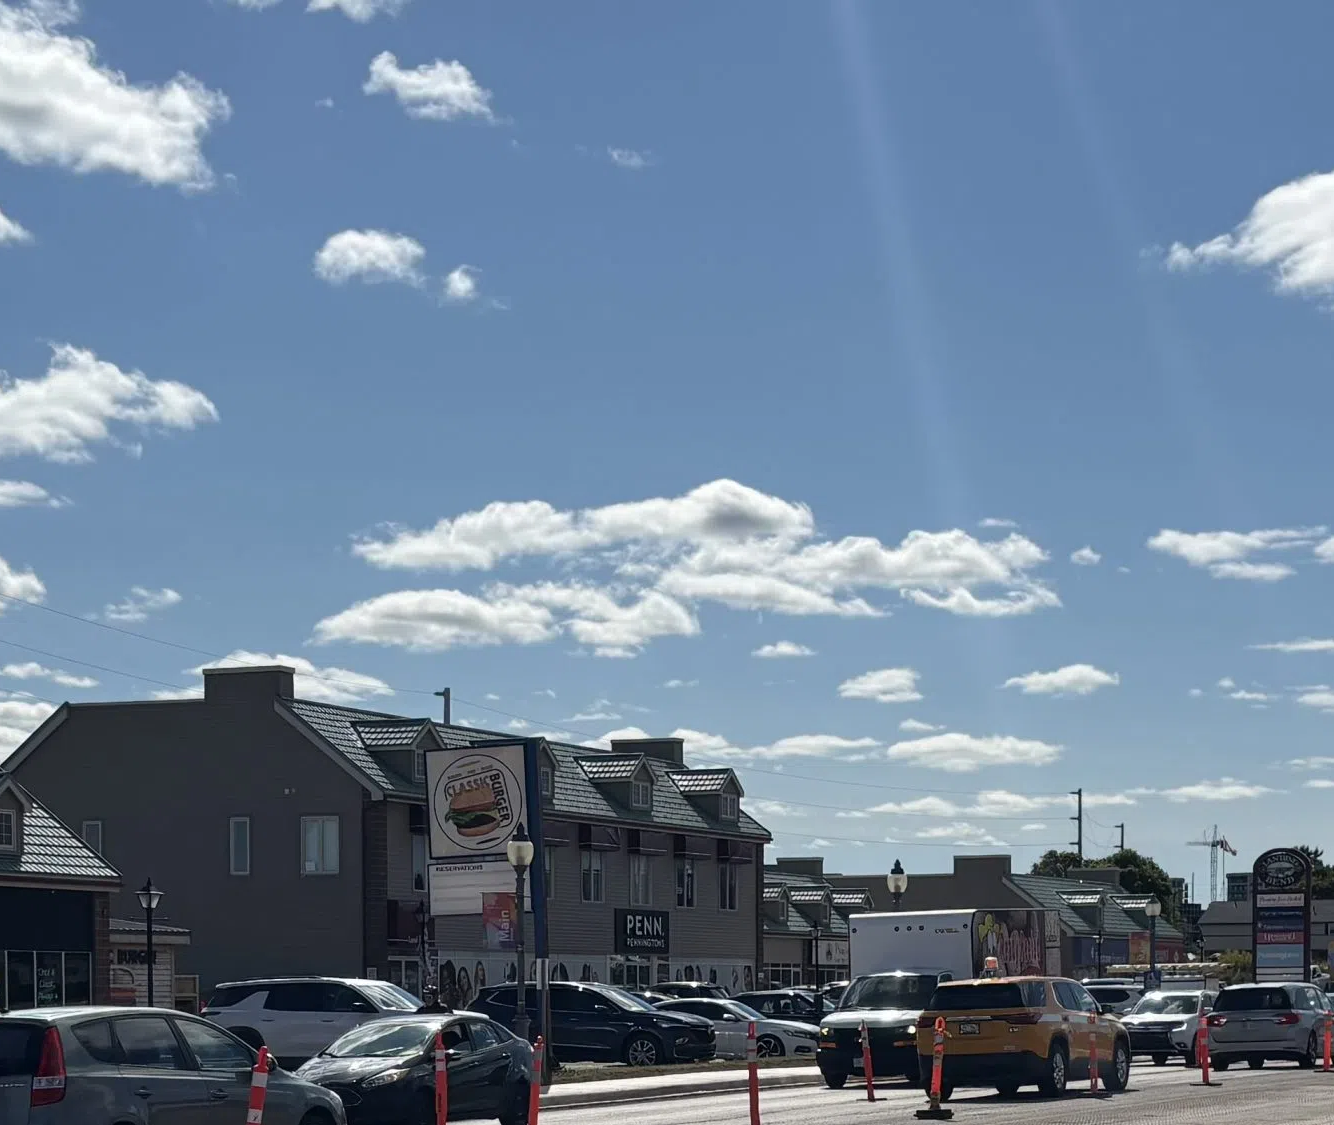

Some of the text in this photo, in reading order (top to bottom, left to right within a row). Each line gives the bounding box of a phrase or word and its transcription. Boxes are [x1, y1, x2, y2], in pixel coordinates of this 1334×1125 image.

[446, 775, 490, 798] CLASSIC
[489, 773, 511, 822] BURGER
[499, 910, 510, 942] Main
